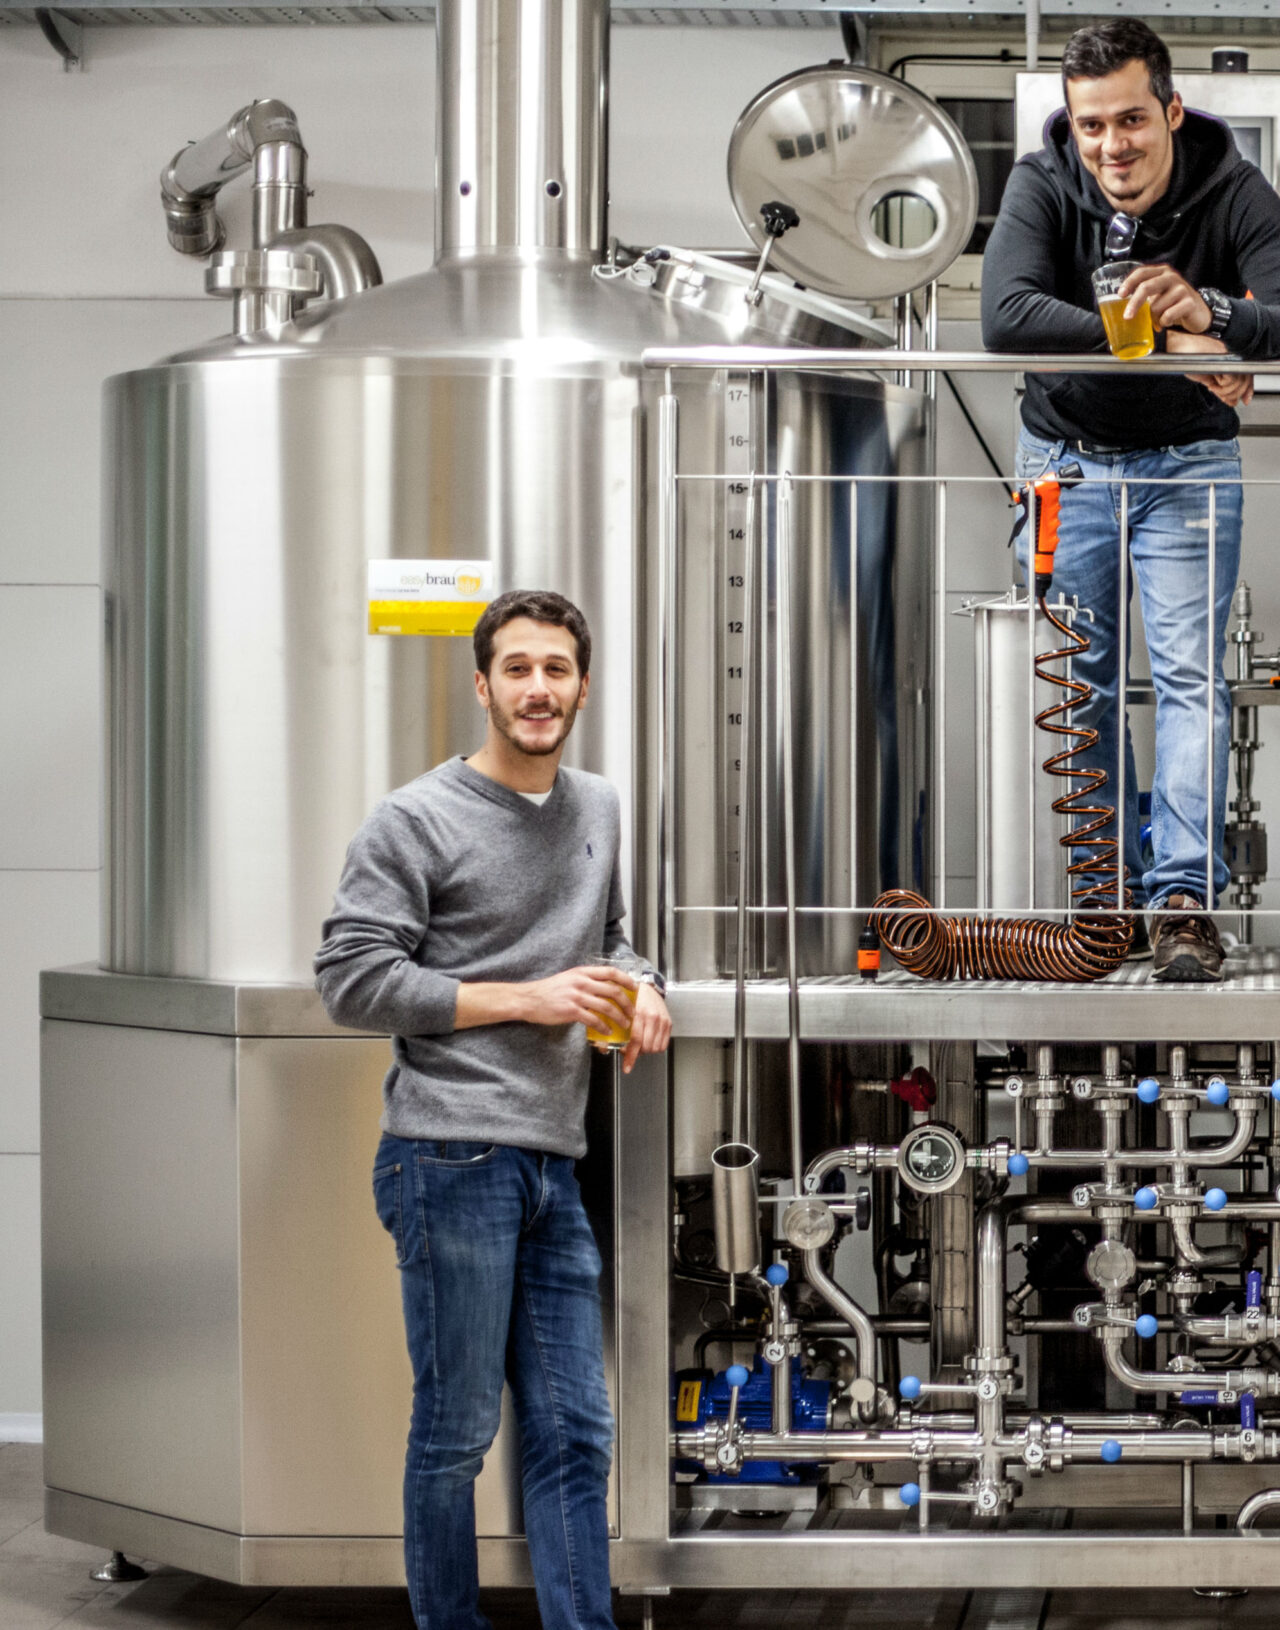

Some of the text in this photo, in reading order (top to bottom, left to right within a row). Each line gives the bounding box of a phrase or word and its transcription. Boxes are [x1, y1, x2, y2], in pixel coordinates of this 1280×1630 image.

[728, 389, 743, 401] 17
[729, 435, 744, 447] 16
[728, 482, 743, 494] 15
[729, 529, 744, 540] 14
[728, 576, 743, 587] 13
[728, 621, 743, 633] 12
[728, 667, 742, 679] 11
[728, 713, 742, 725] 10
[1077, 1082, 1086, 1093] 11
[808, 1177, 815, 1188] 7
[1075, 1191, 1085, 1202] 12
[1076, 1311, 1087, 1322] 15
[1247, 1310, 1259, 1320] 22
[770, 1348, 780, 1356] 2
[983, 1384, 990, 1395] 3
[1223, 1391, 1233, 1402] 19
[1244, 1432, 1251, 1442] 6
[723, 1450, 728, 1460] 1
[1029, 1449, 1039, 1457] 4
[983, 1494, 991, 1505] 5
